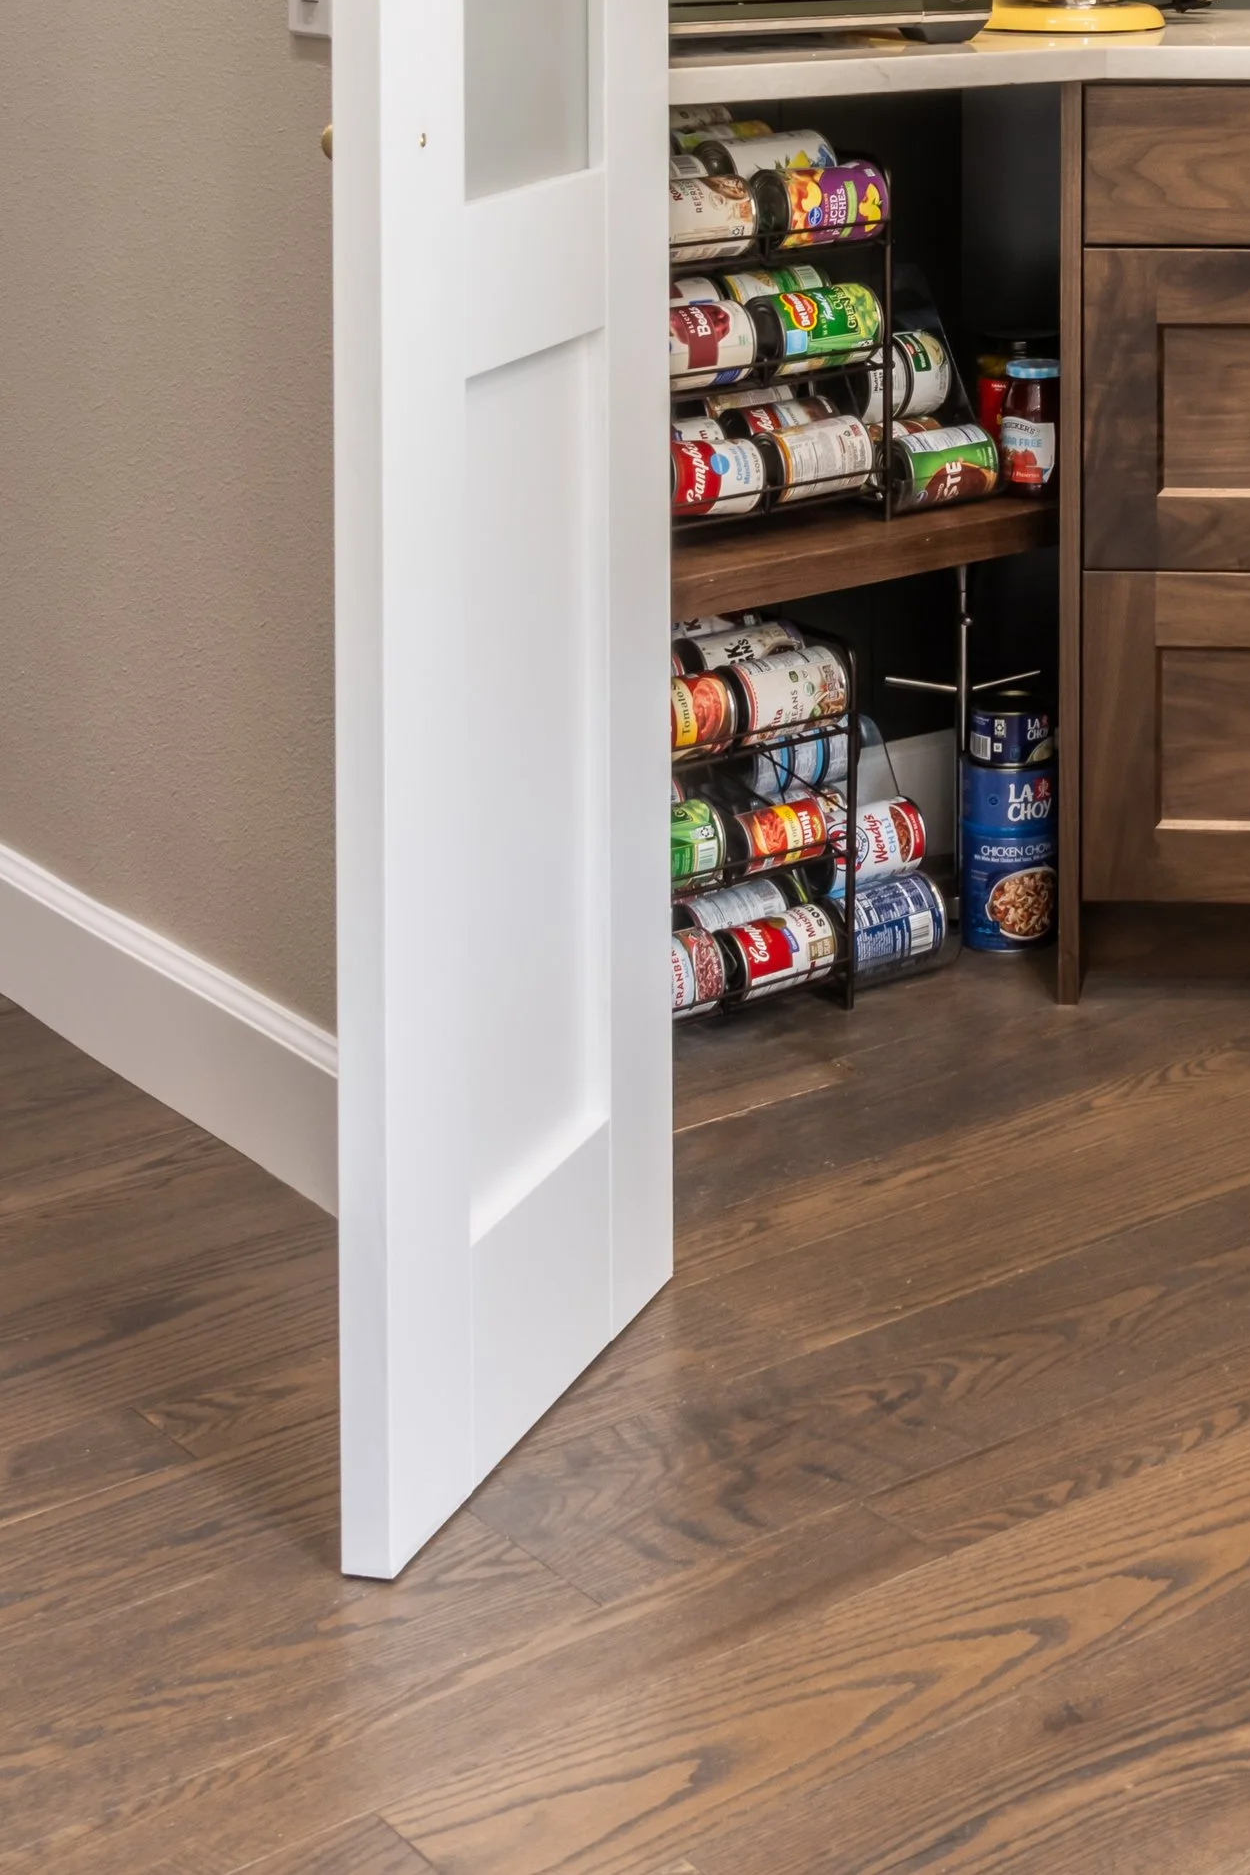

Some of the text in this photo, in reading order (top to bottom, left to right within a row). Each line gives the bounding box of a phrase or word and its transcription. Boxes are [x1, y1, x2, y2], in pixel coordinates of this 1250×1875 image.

[1003, 421, 1036, 436] MUCKER'S
[1008, 783, 1034, 803] LA
[1007, 797, 1052, 822] CHOY
[863, 812, 890, 865] Wendy's
[882, 816, 897, 854] CHILI
[980, 844, 1024, 858] CHICKEN
[671, 947, 684, 1007] CRANBER
